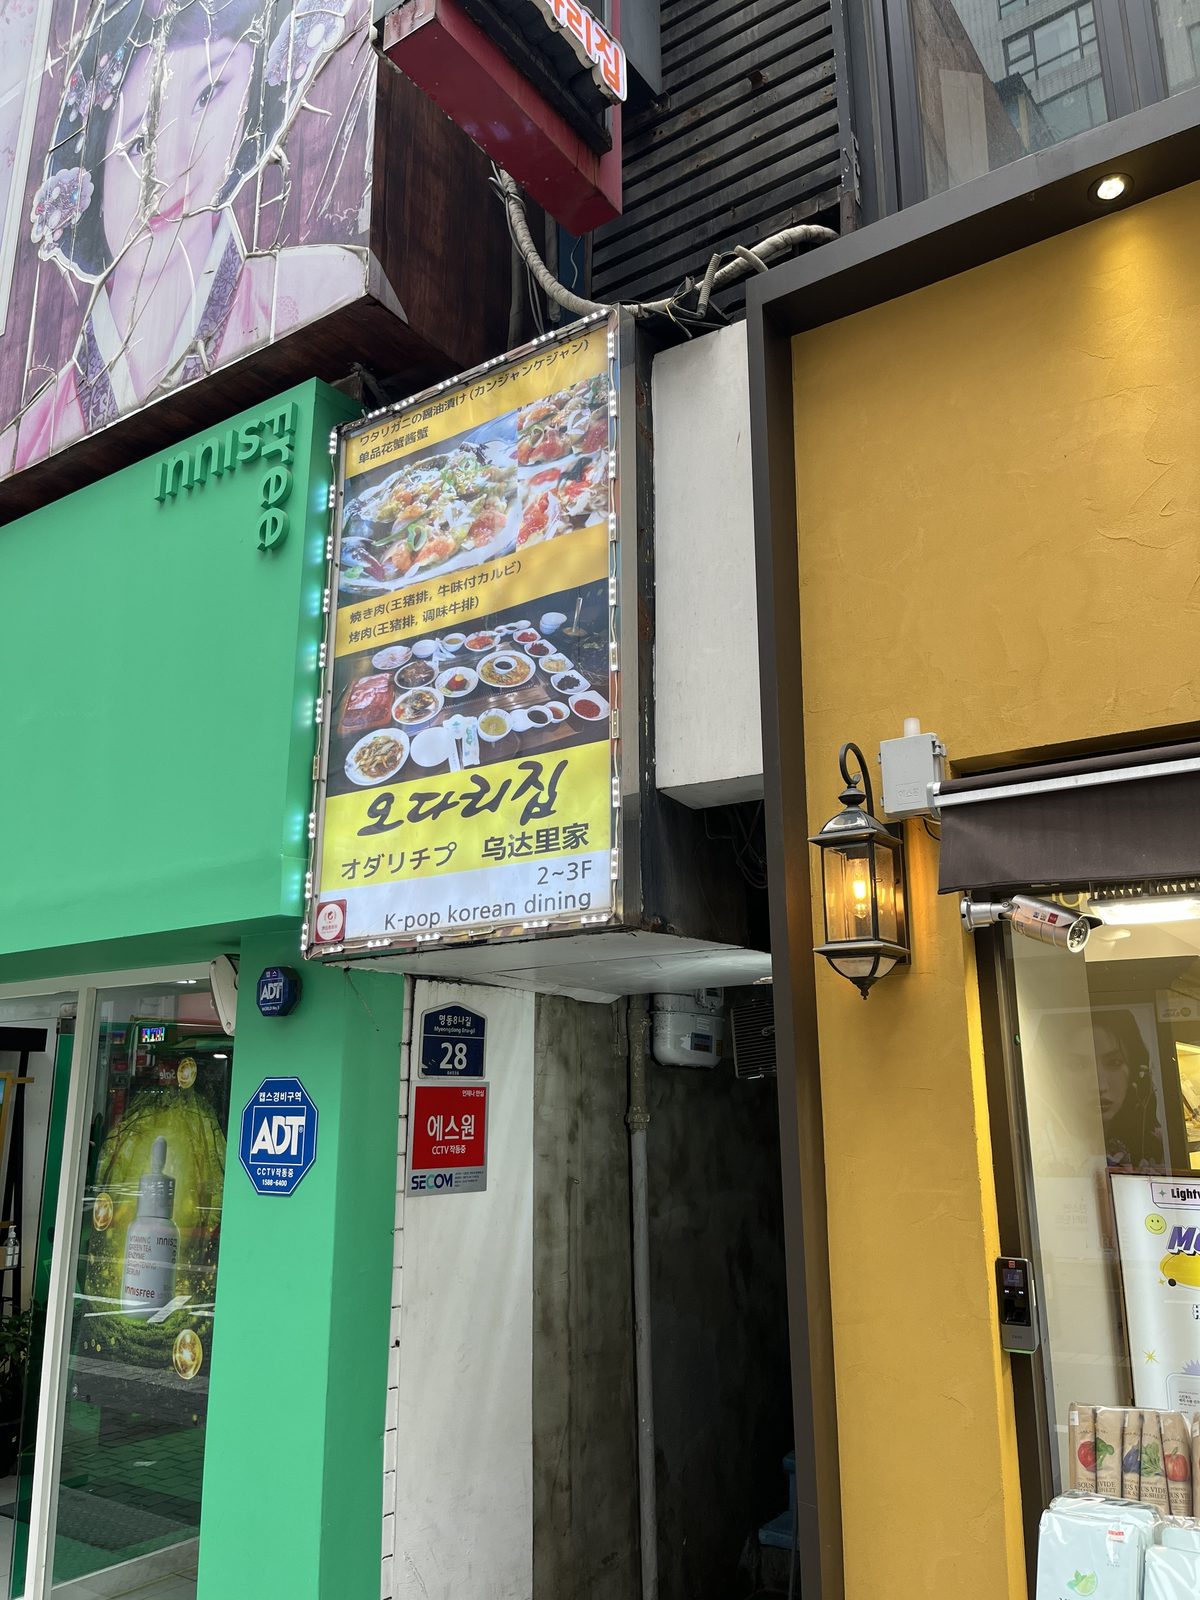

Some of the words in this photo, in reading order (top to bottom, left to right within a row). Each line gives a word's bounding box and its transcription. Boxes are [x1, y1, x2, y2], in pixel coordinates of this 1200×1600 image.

[357, 759, 569, 837] 오다리집
[341, 841, 458, 880] オダリチプ
[481, 822, 589, 861] 乌达里家
[537, 859, 592, 886] 2~3F
[384, 909, 441, 932] K-pop
[448, 900, 516, 924] korean
[524, 891, 592, 915] dining
[260, 982, 283, 1001] ADT
[438, 1014, 472, 1027] 명동8나길
[439, 1042, 468, 1070] 28
[250, 1115, 306, 1156] ADT
[427, 1114, 475, 1141] 에스원
[431, 1145, 450, 1155] CCTV
[262, 1178, 288, 1187] 1588-6400
[411, 1172, 454, 1190] SECOM
